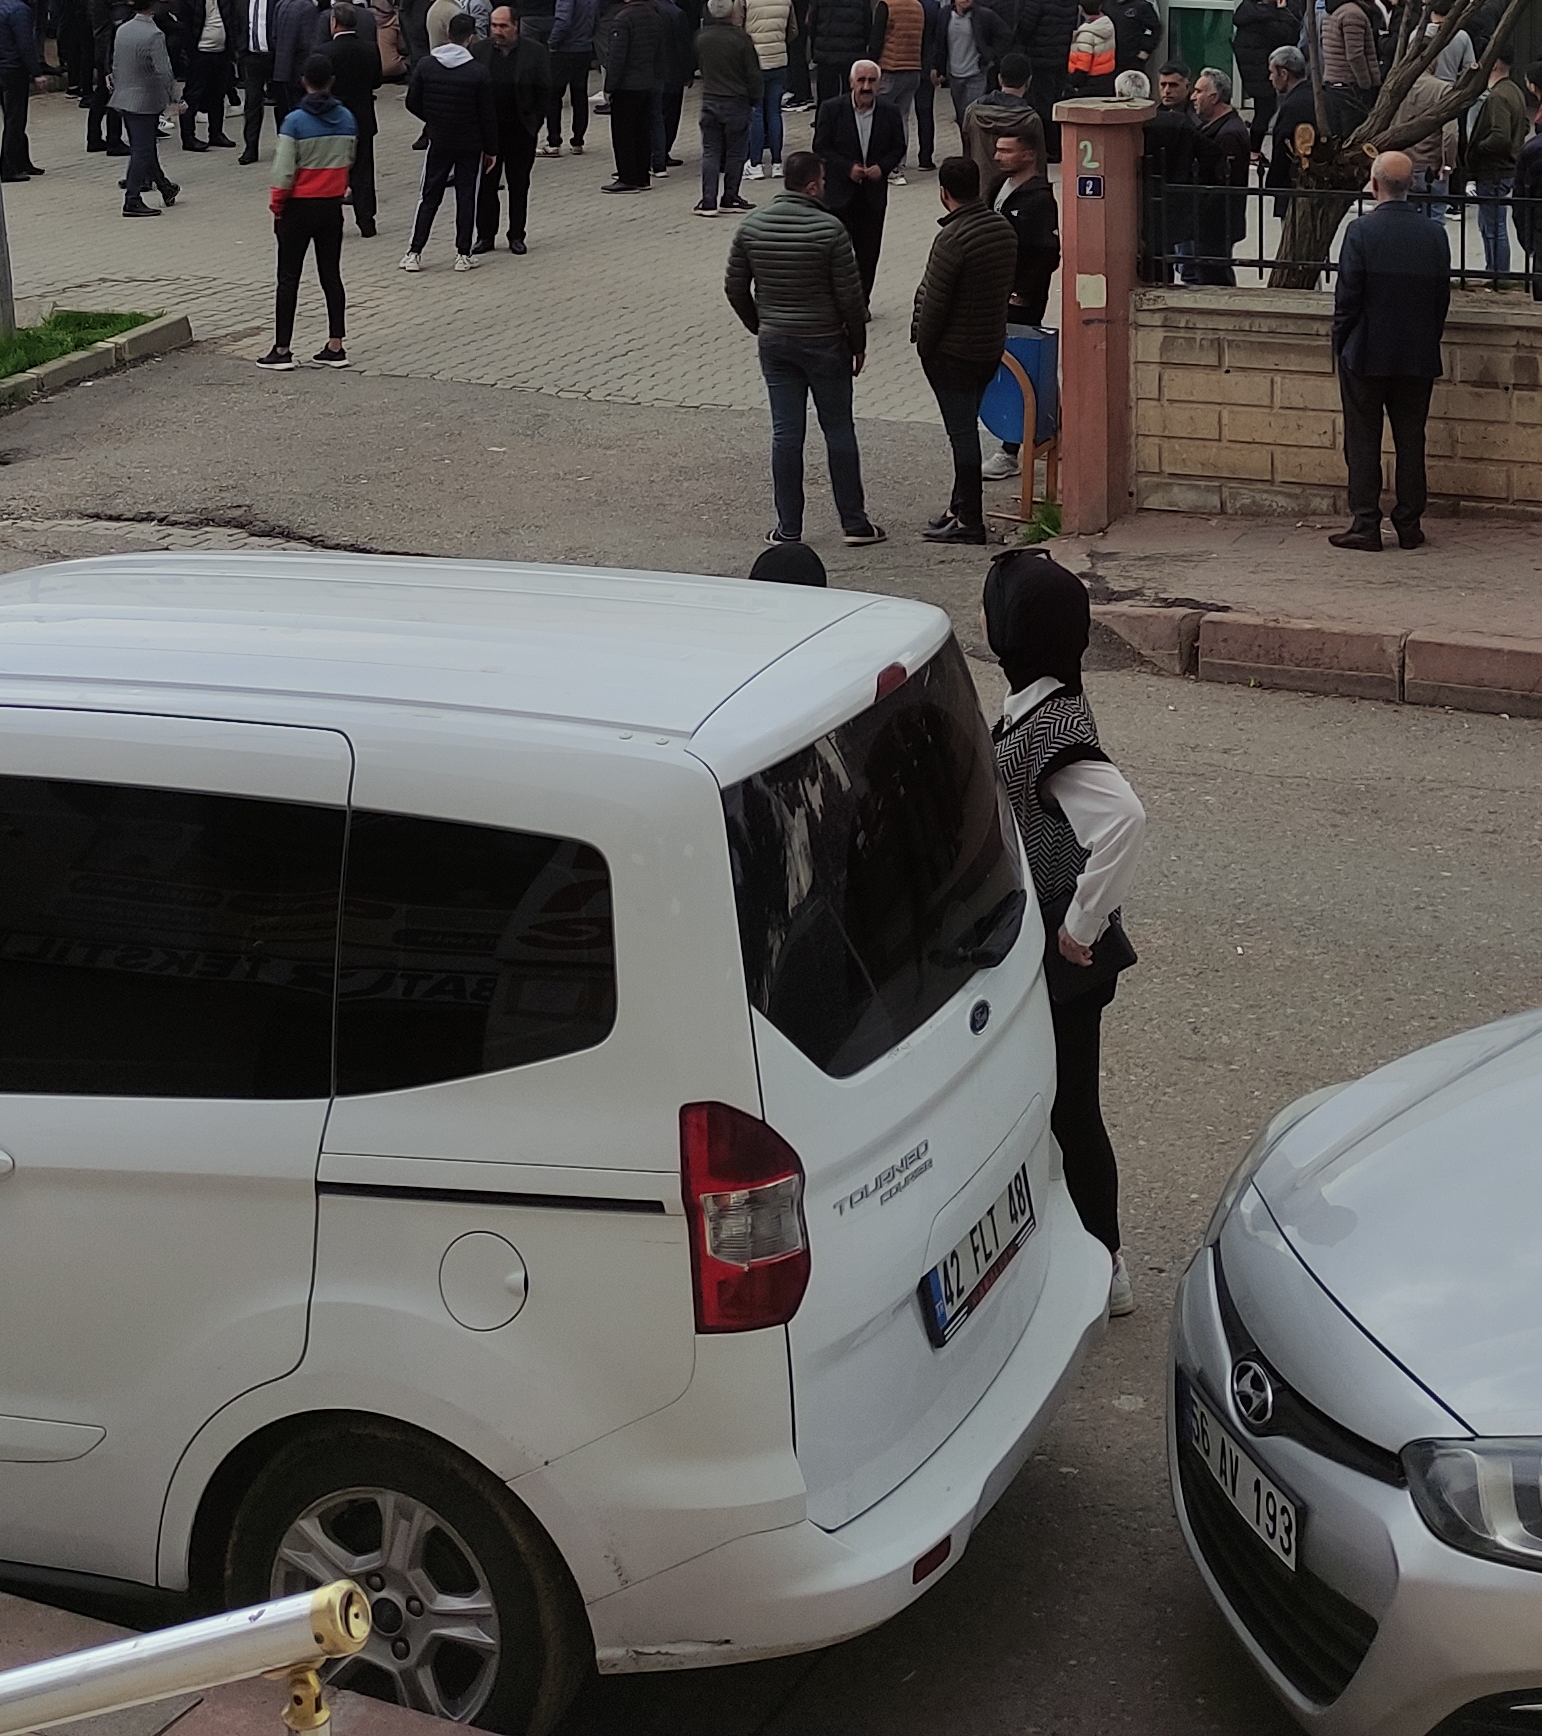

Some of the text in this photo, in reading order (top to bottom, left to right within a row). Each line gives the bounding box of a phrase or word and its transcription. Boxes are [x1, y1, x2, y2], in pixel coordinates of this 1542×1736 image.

[1079, 140, 1100, 169] 2
[832, 1139, 929, 1216] TOURNEO
[943, 1250, 964, 1306] 42
[969, 1204, 1000, 1275] FLT
[1008, 1171, 1027, 1225] 48
[1219, 1436, 1239, 1498] AV
[1253, 1477, 1293, 1557] 193
